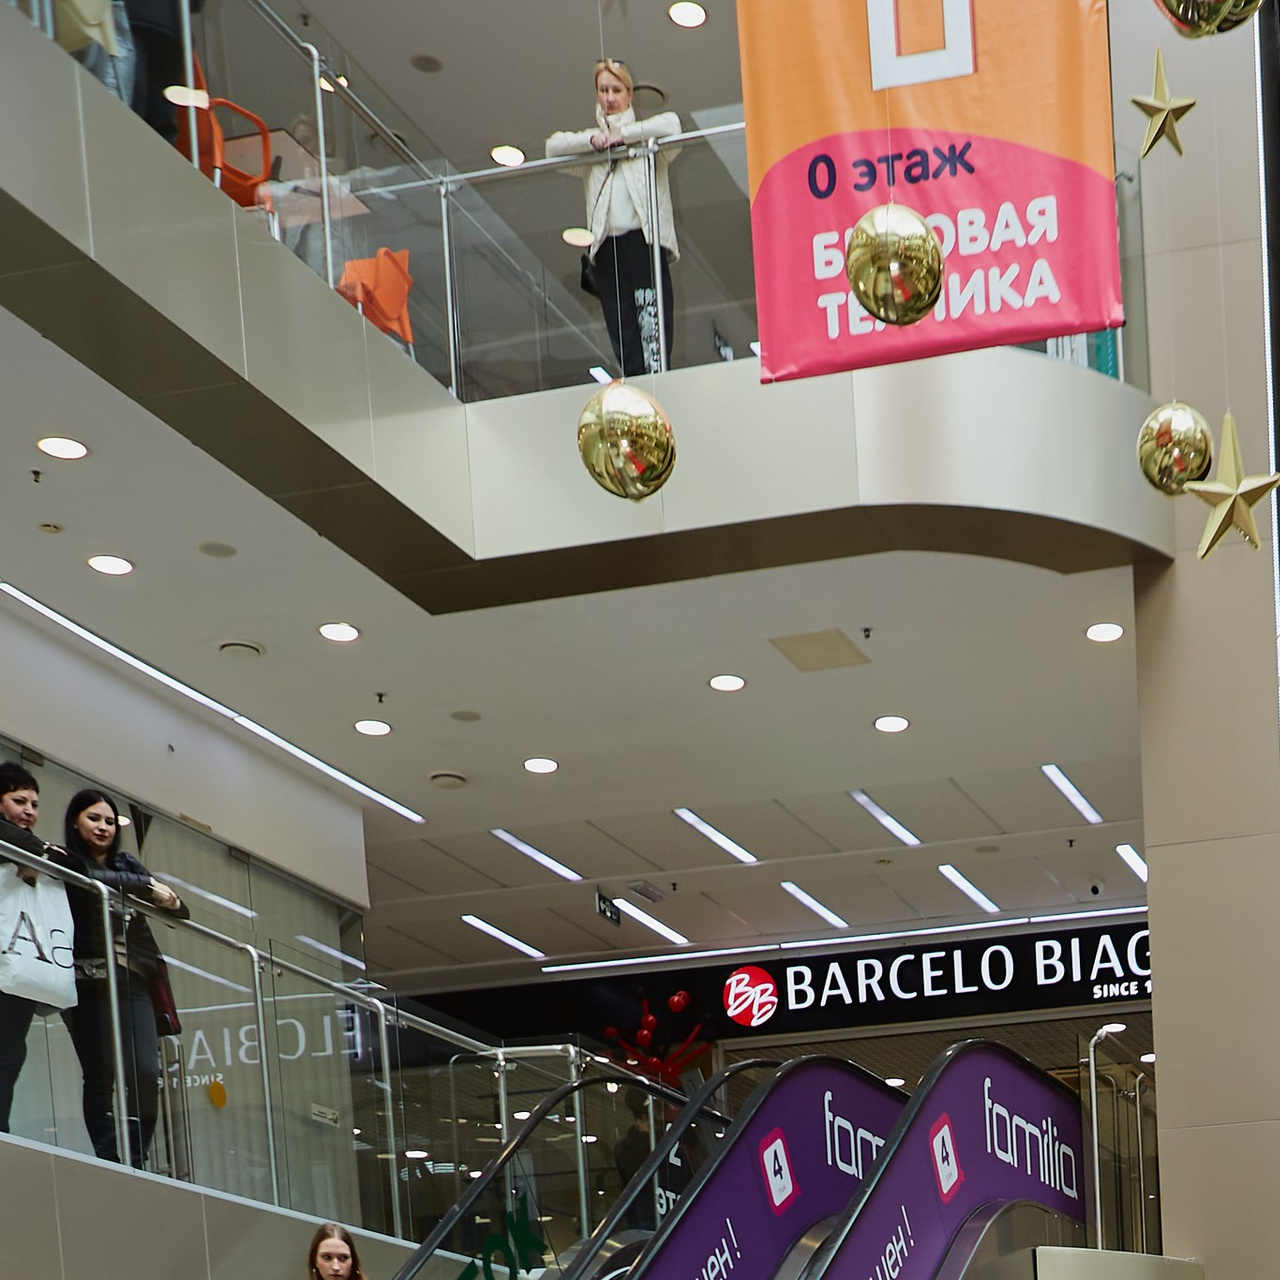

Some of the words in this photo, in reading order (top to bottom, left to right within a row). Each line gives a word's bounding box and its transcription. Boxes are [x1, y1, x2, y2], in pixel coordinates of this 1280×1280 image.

[808, 154, 836, 199] 0
[852, 141, 975, 192] этаж
[786, 944, 1014, 1010] BARCELO
[1092, 981, 1138, 999] SINCE
[941, 1134, 950, 1166] 4
[983, 1076, 1079, 1200] familia
[772, 1148, 783, 1180] 4
